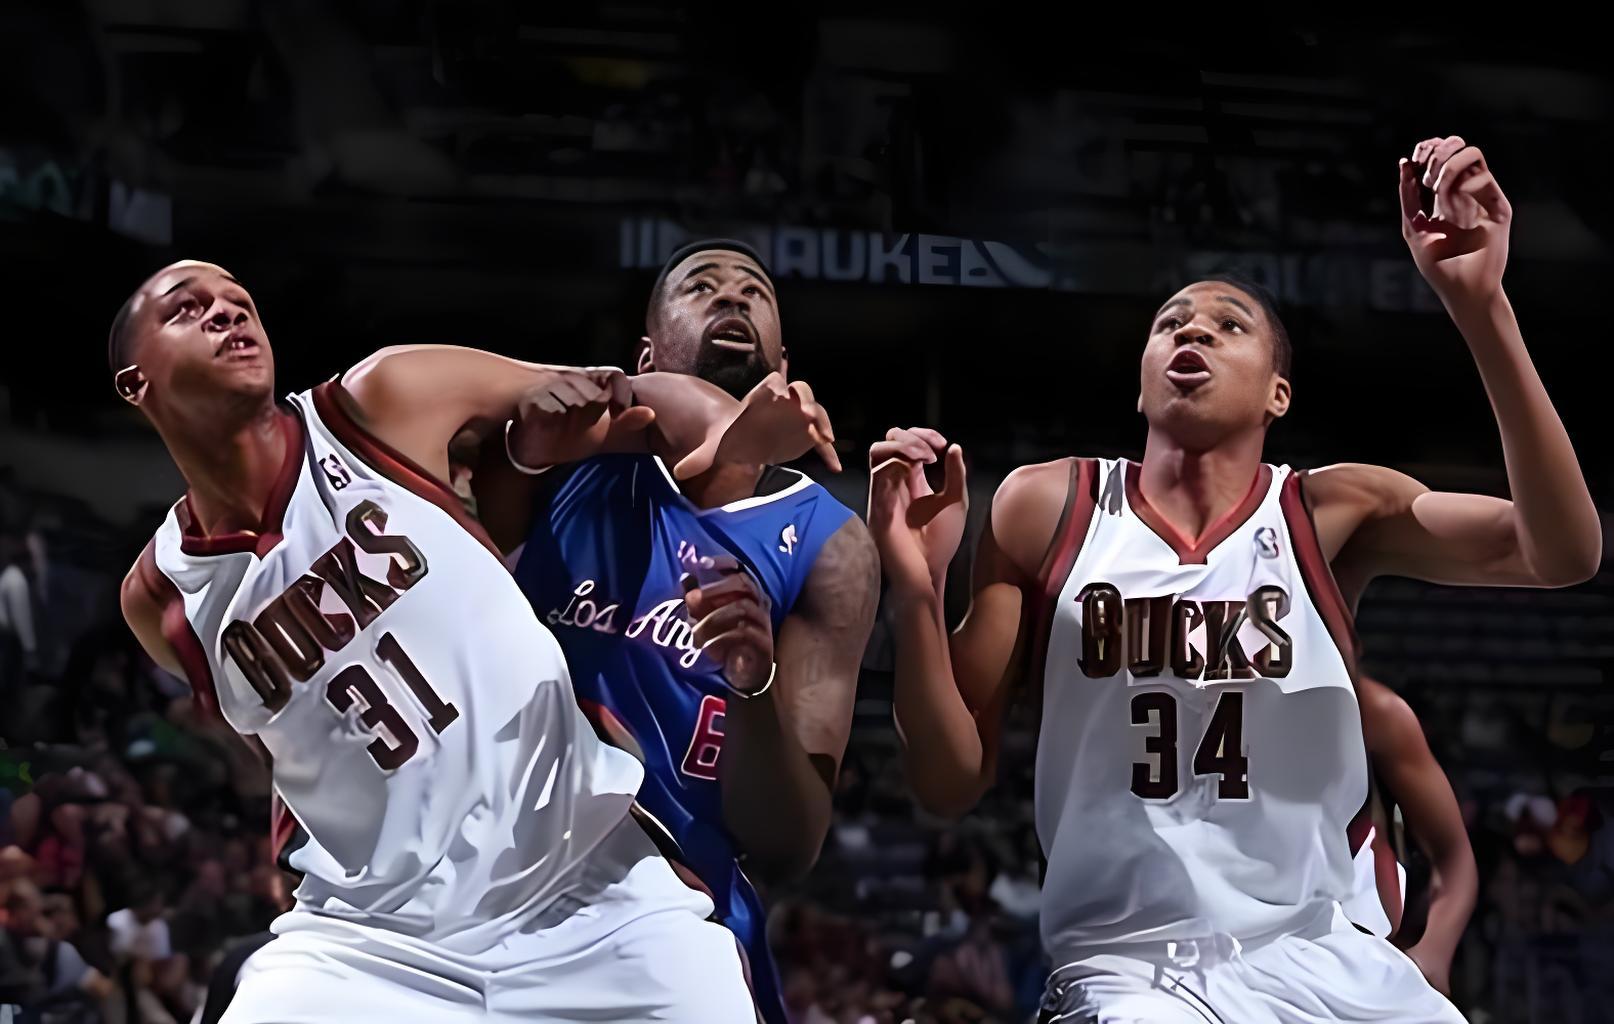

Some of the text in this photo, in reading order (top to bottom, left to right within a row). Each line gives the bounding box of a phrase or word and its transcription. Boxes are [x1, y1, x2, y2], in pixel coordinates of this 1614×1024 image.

[221, 499, 429, 716] BUCKS
[546, 579, 624, 634] Los
[1075, 582, 1293, 680] BUCKS
[324, 630, 460, 771] 31
[681, 694, 728, 781] 6
[1131, 691, 1250, 801] 34
